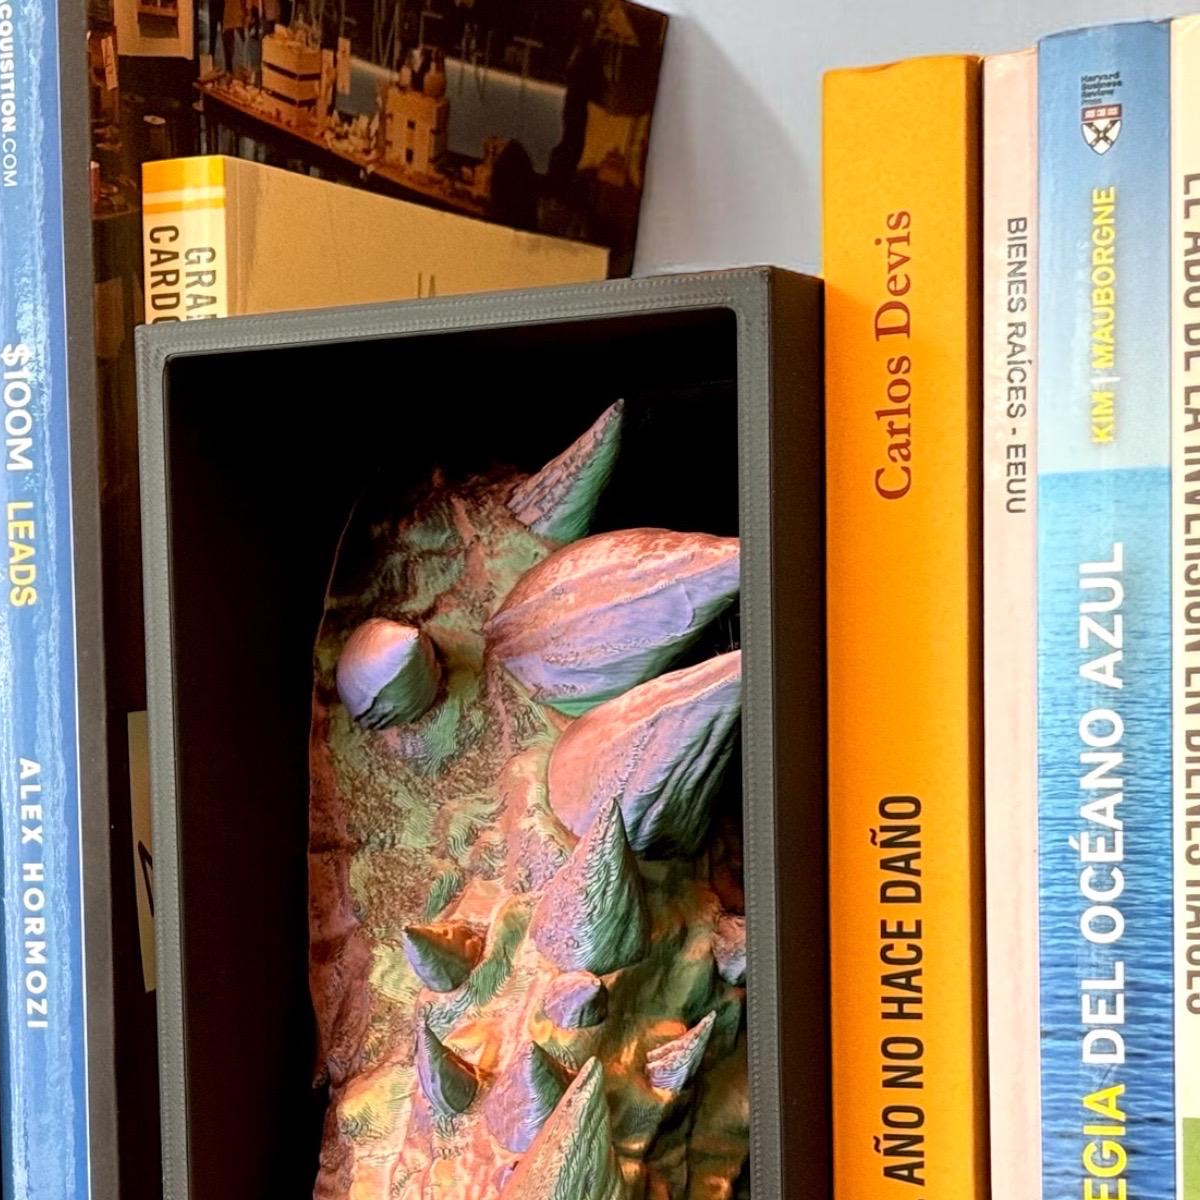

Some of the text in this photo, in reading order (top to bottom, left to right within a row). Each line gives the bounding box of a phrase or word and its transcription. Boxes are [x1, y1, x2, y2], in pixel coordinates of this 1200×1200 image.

[185, 247, 217, 320] GRA
[1007, 216, 1027, 313] BIENES
[1090, 186, 1116, 369] MAUBORGNE
[874, 210, 911, 500] Carlos Devis
[1006, 320, 1033, 419] RAÍCES
[1090, 390, 1115, 443] KIM
[0, 343, 37, 607] $100M LEADS
[1006, 443, 1027, 514] EEUU
[1079, 541, 1125, 690] AZUL
[869, 795, 923, 905] DAÑO
[1069, 708, 1125, 943] OCÉANO
[19, 757, 49, 1029] ALEX HORMOZI
[879, 919, 923, 1021] HACE
[1081, 961, 1125, 1064] DEL
[880, 1036, 925, 1090] NO
[873, 1104, 925, 1186] AÑO
